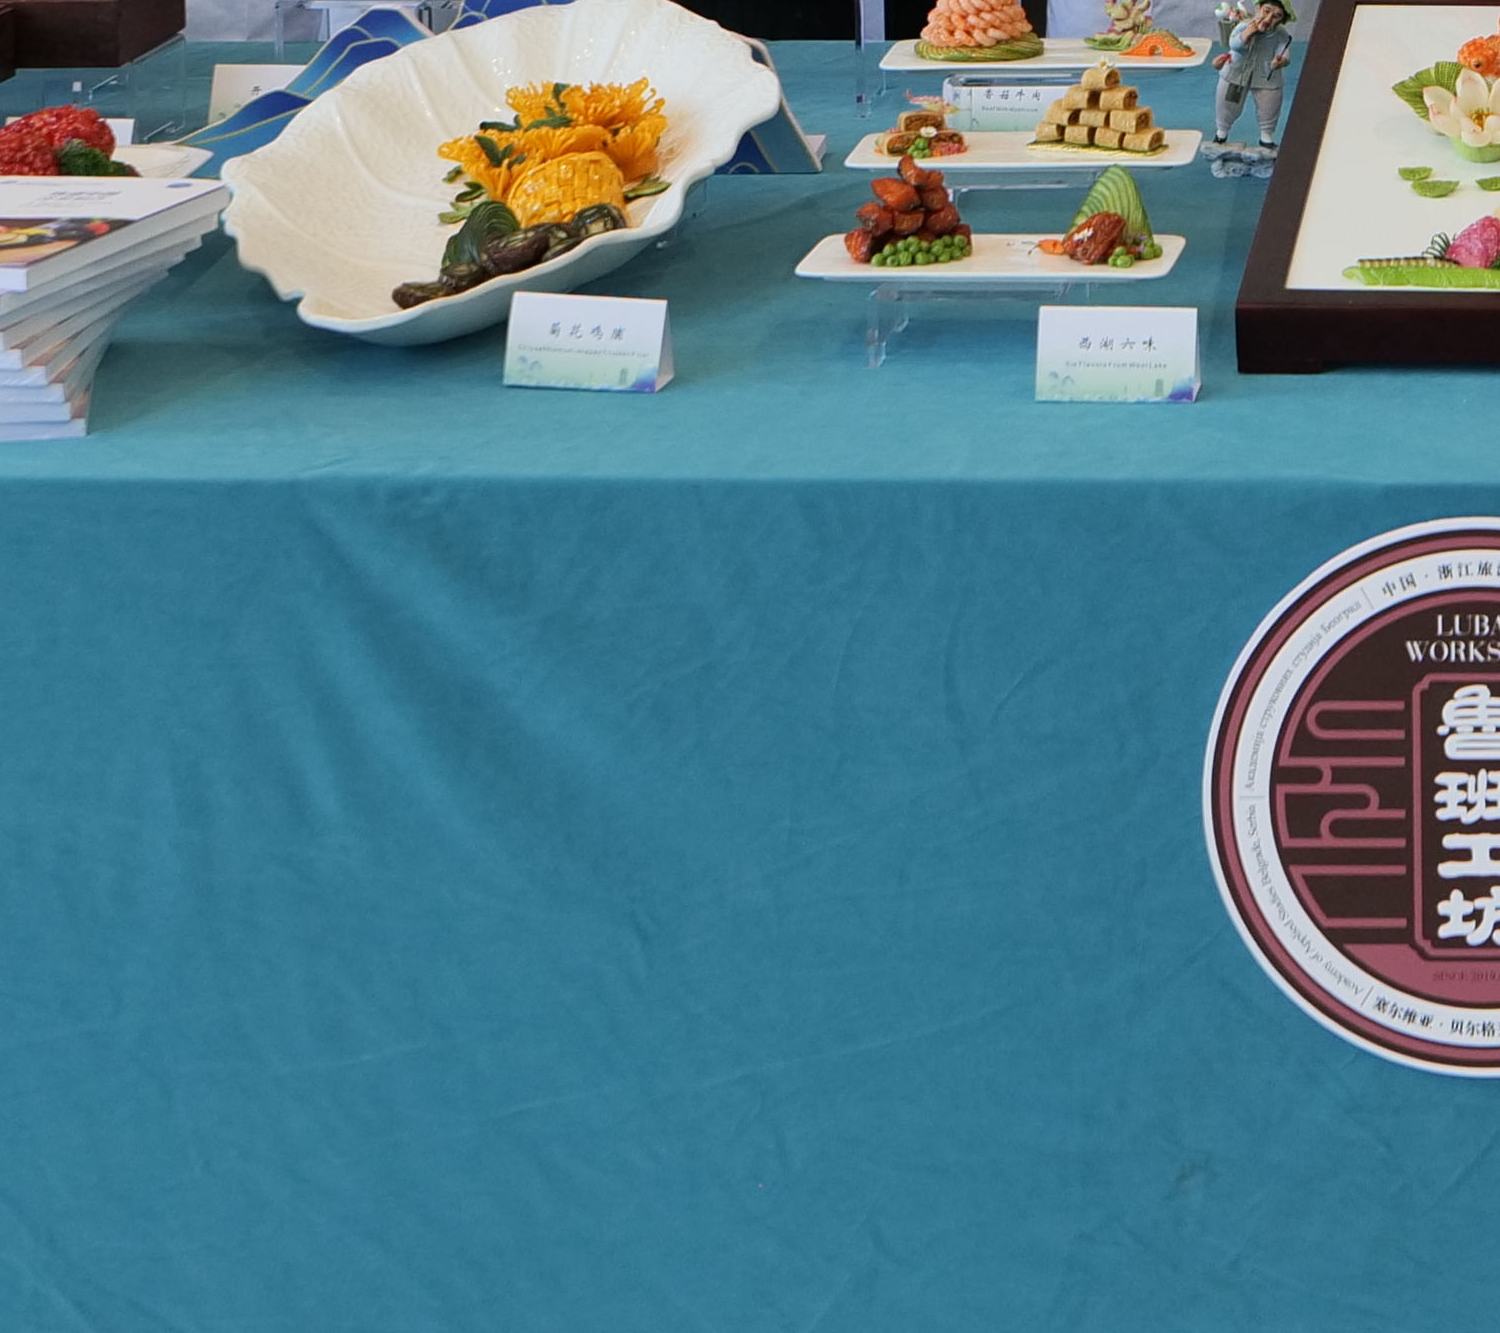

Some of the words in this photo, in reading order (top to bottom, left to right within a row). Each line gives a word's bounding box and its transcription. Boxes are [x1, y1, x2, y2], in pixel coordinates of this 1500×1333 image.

[1079, 336, 1157, 352] 西湖六味
[1243, 803, 1260, 838] Serbia
[1263, 884, 1292, 924] Studies
[1280, 916, 1318, 959] Applied
[1307, 950, 1326, 968] of
[1318, 958, 1365, 1000] Academy
